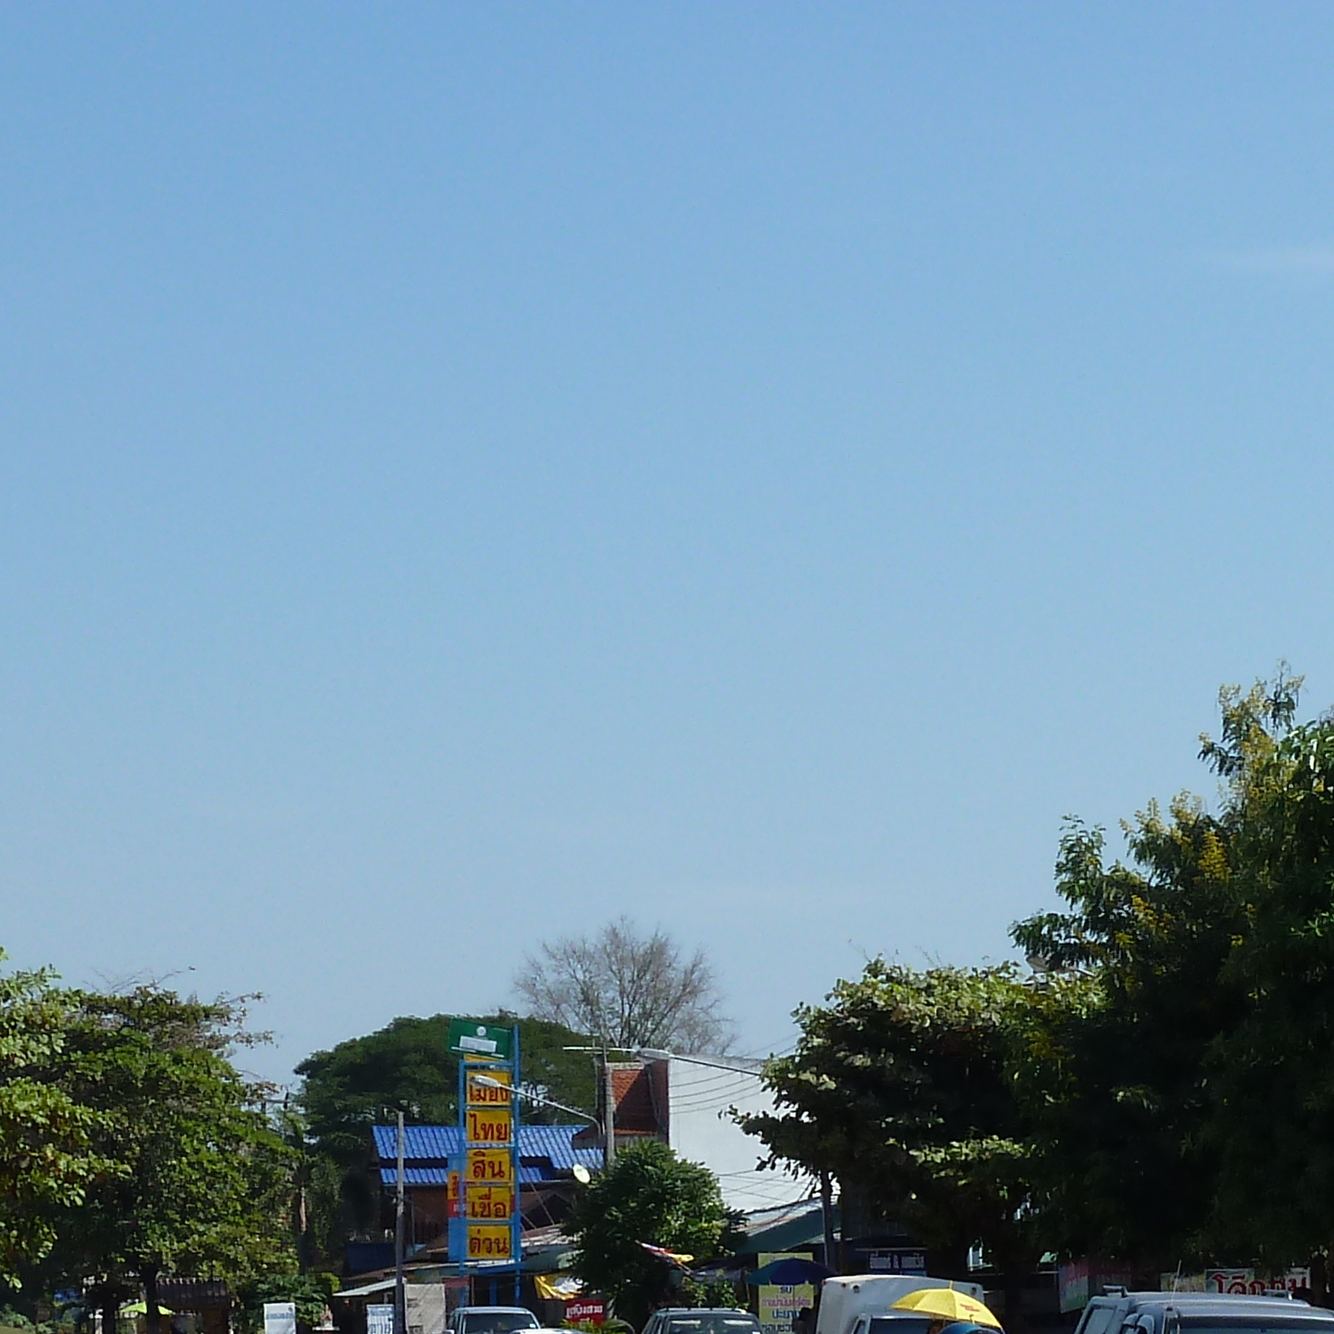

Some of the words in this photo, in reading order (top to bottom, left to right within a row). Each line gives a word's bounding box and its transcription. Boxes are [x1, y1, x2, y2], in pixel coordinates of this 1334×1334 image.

[469, 1113, 508, 1142] ไทย
[472, 1149, 505, 1178] สิน
[469, 1228, 509, 1254] ด่วน
